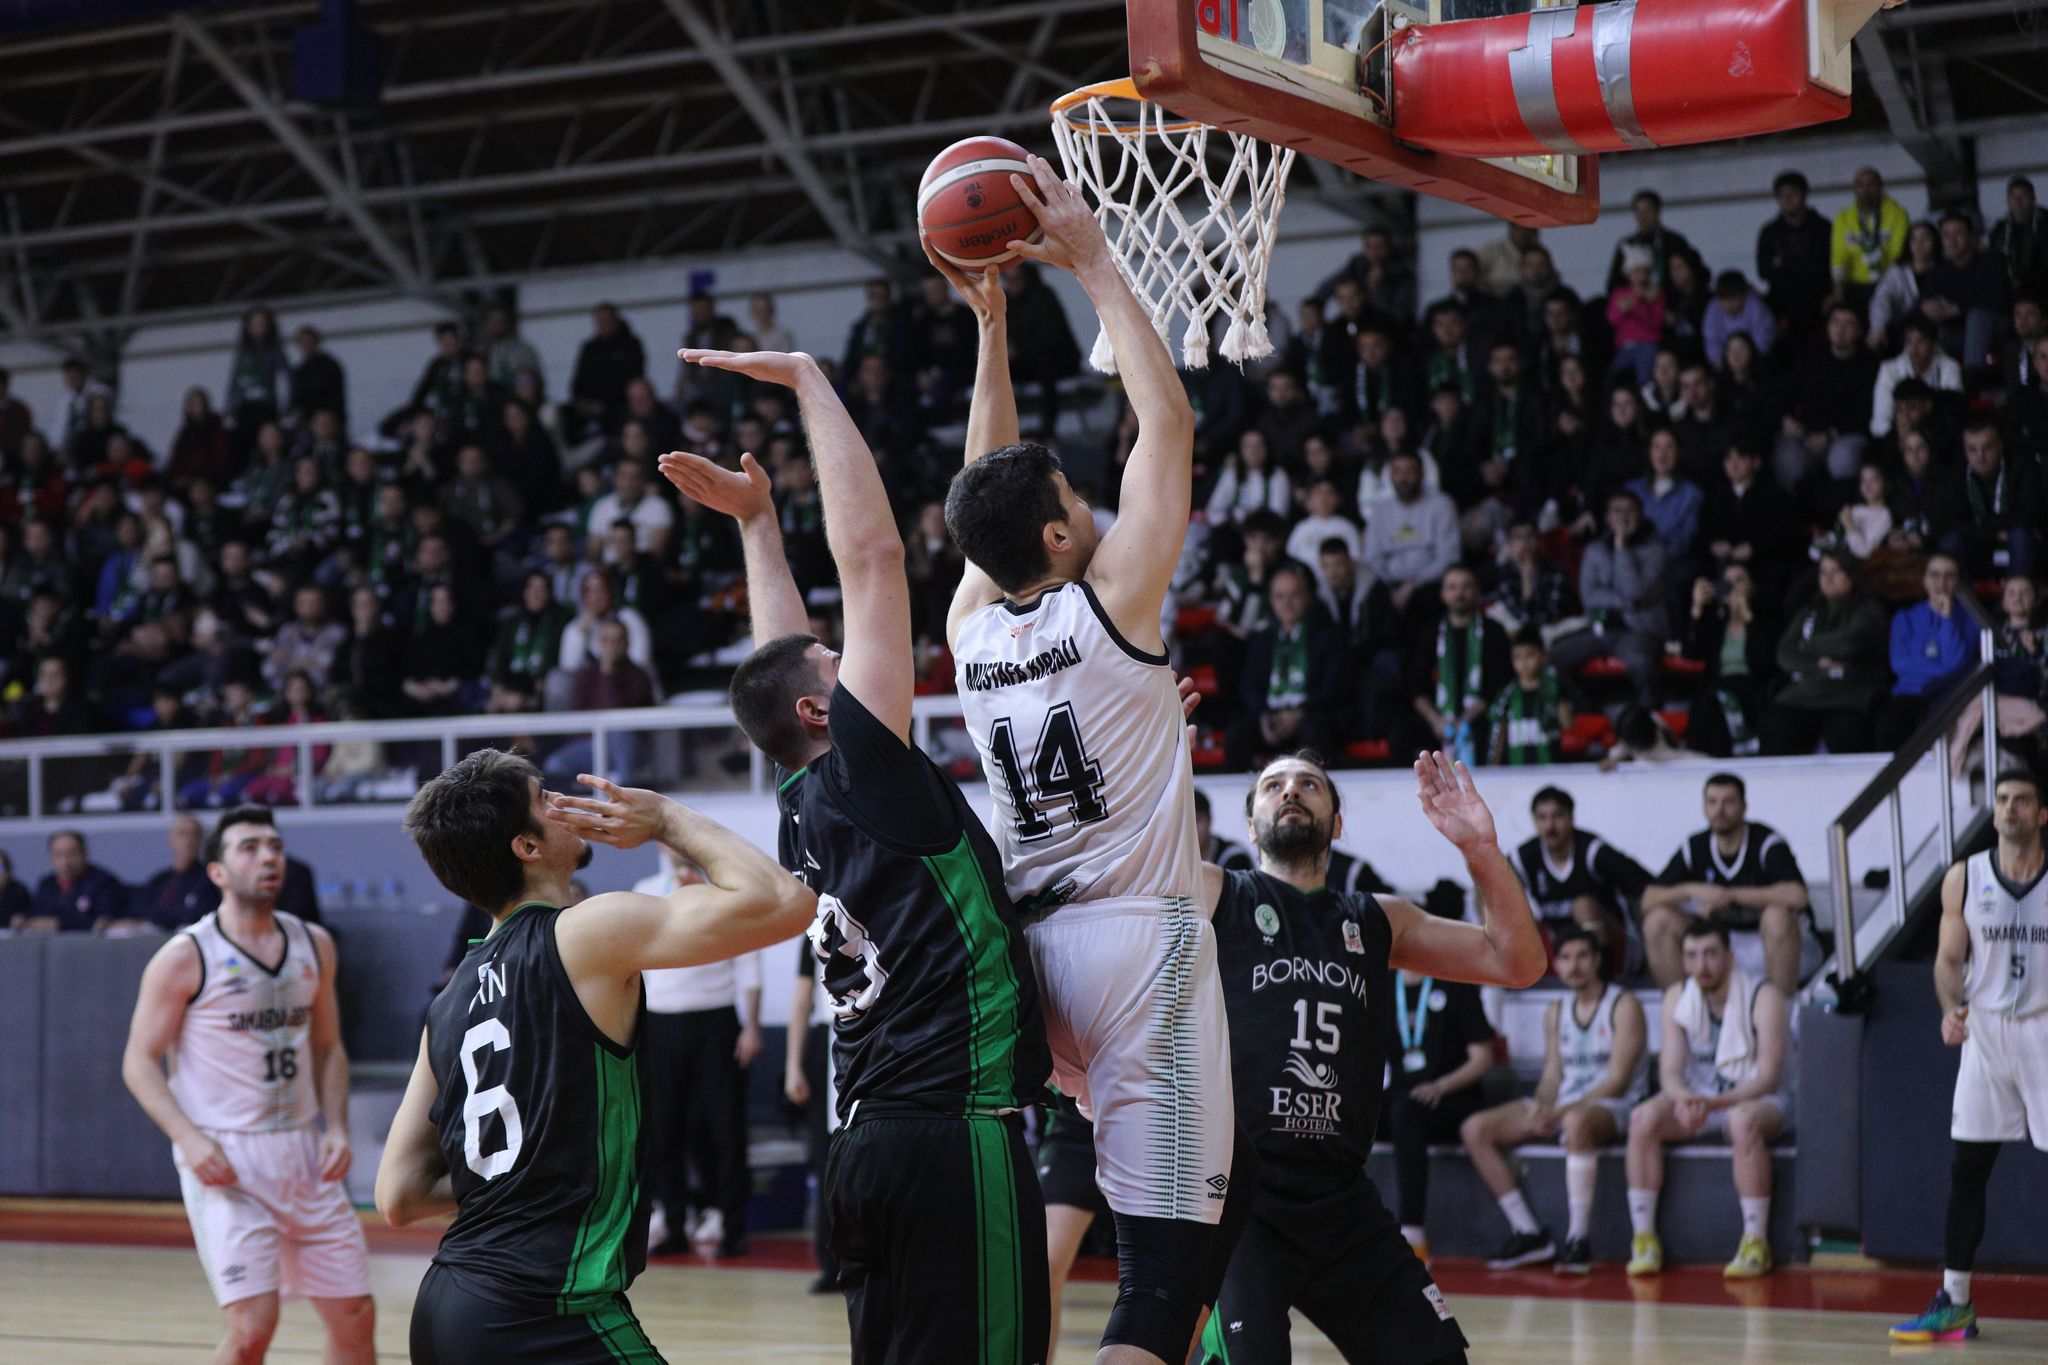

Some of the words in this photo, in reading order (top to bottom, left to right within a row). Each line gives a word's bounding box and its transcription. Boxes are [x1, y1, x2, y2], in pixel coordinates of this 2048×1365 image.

[959, 221, 1017, 248] molten
[988, 700, 1109, 844] 14
[1252, 956, 1367, 1008] BORNOVA
[2010, 954, 2026, 979] 5
[1290, 998, 1343, 1055] 15
[264, 1047, 297, 1082] 16
[460, 1017, 523, 1181] 6
[1268, 1086, 1342, 1122] ESER
[1284, 1116, 1335, 1132] HOTELS
